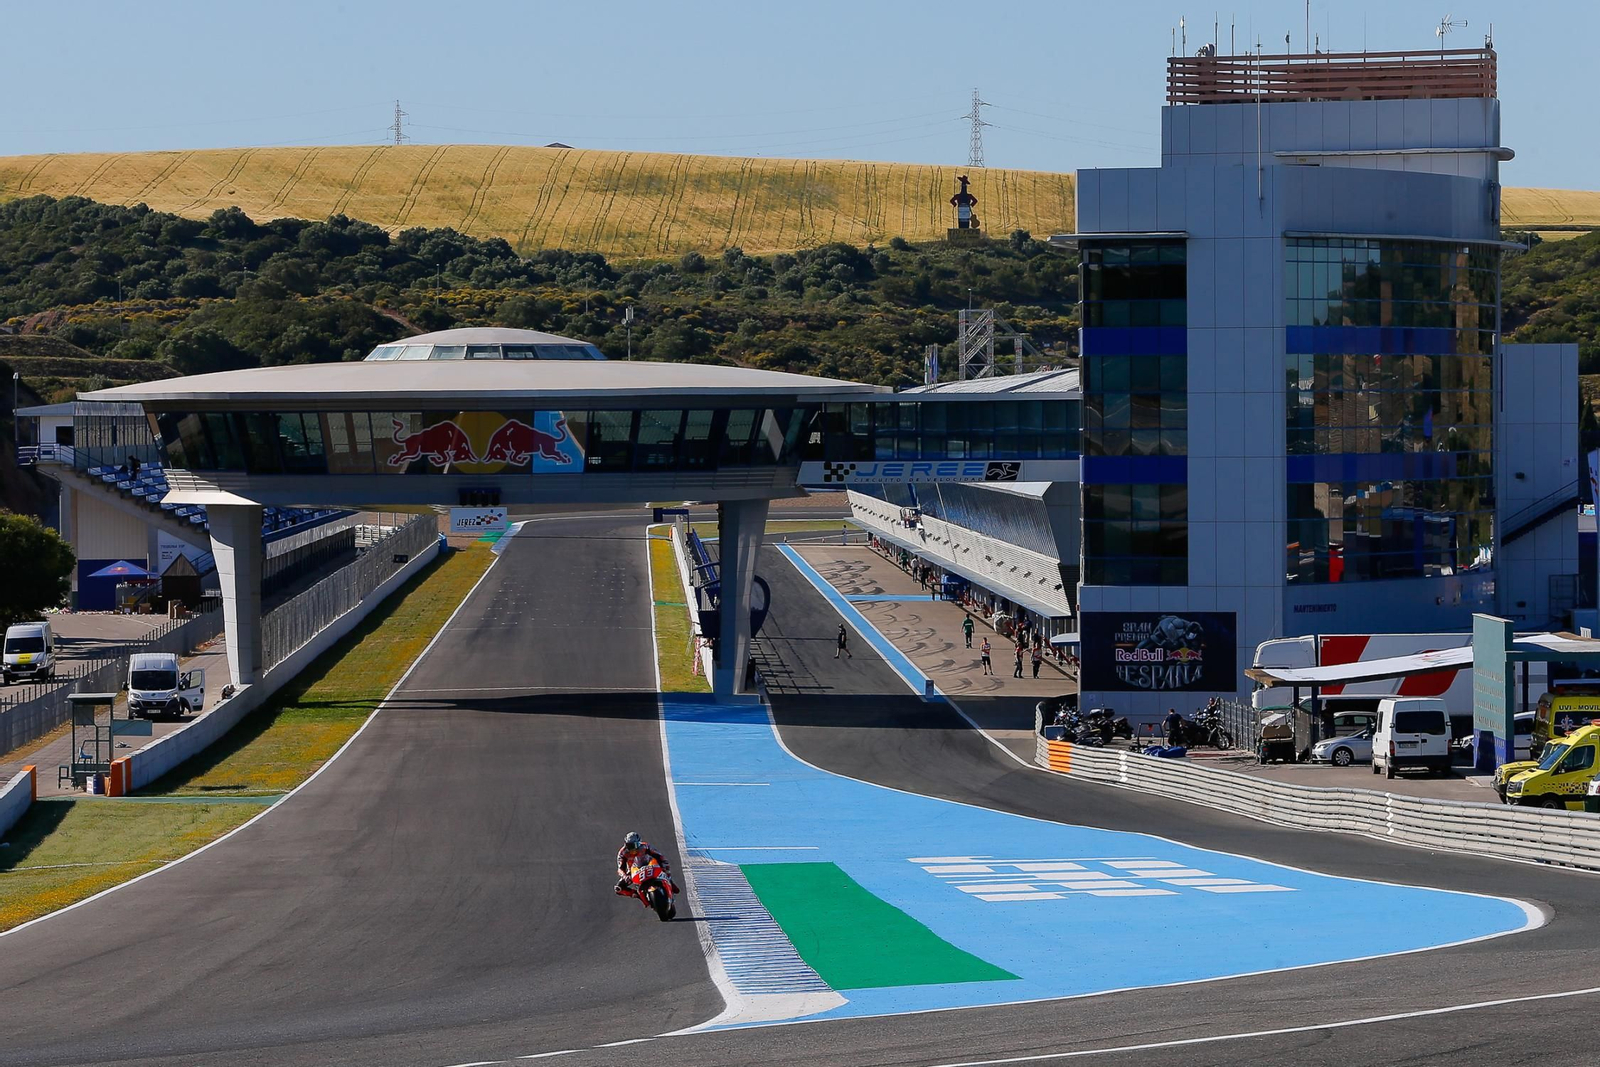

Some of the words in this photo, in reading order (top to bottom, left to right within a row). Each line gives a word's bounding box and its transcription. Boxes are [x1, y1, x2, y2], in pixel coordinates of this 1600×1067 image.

[457, 518, 476, 527] JEREZ
[1293, 603, 1337, 613] MANTENIMIENTO
[1122, 622, 1152, 634] GRAN
[1114, 632, 1150, 643] PREMIO
[1115, 648, 1140, 661] Red
[1139, 648, 1164, 661] Bull
[639, 869, 654, 881] 93
